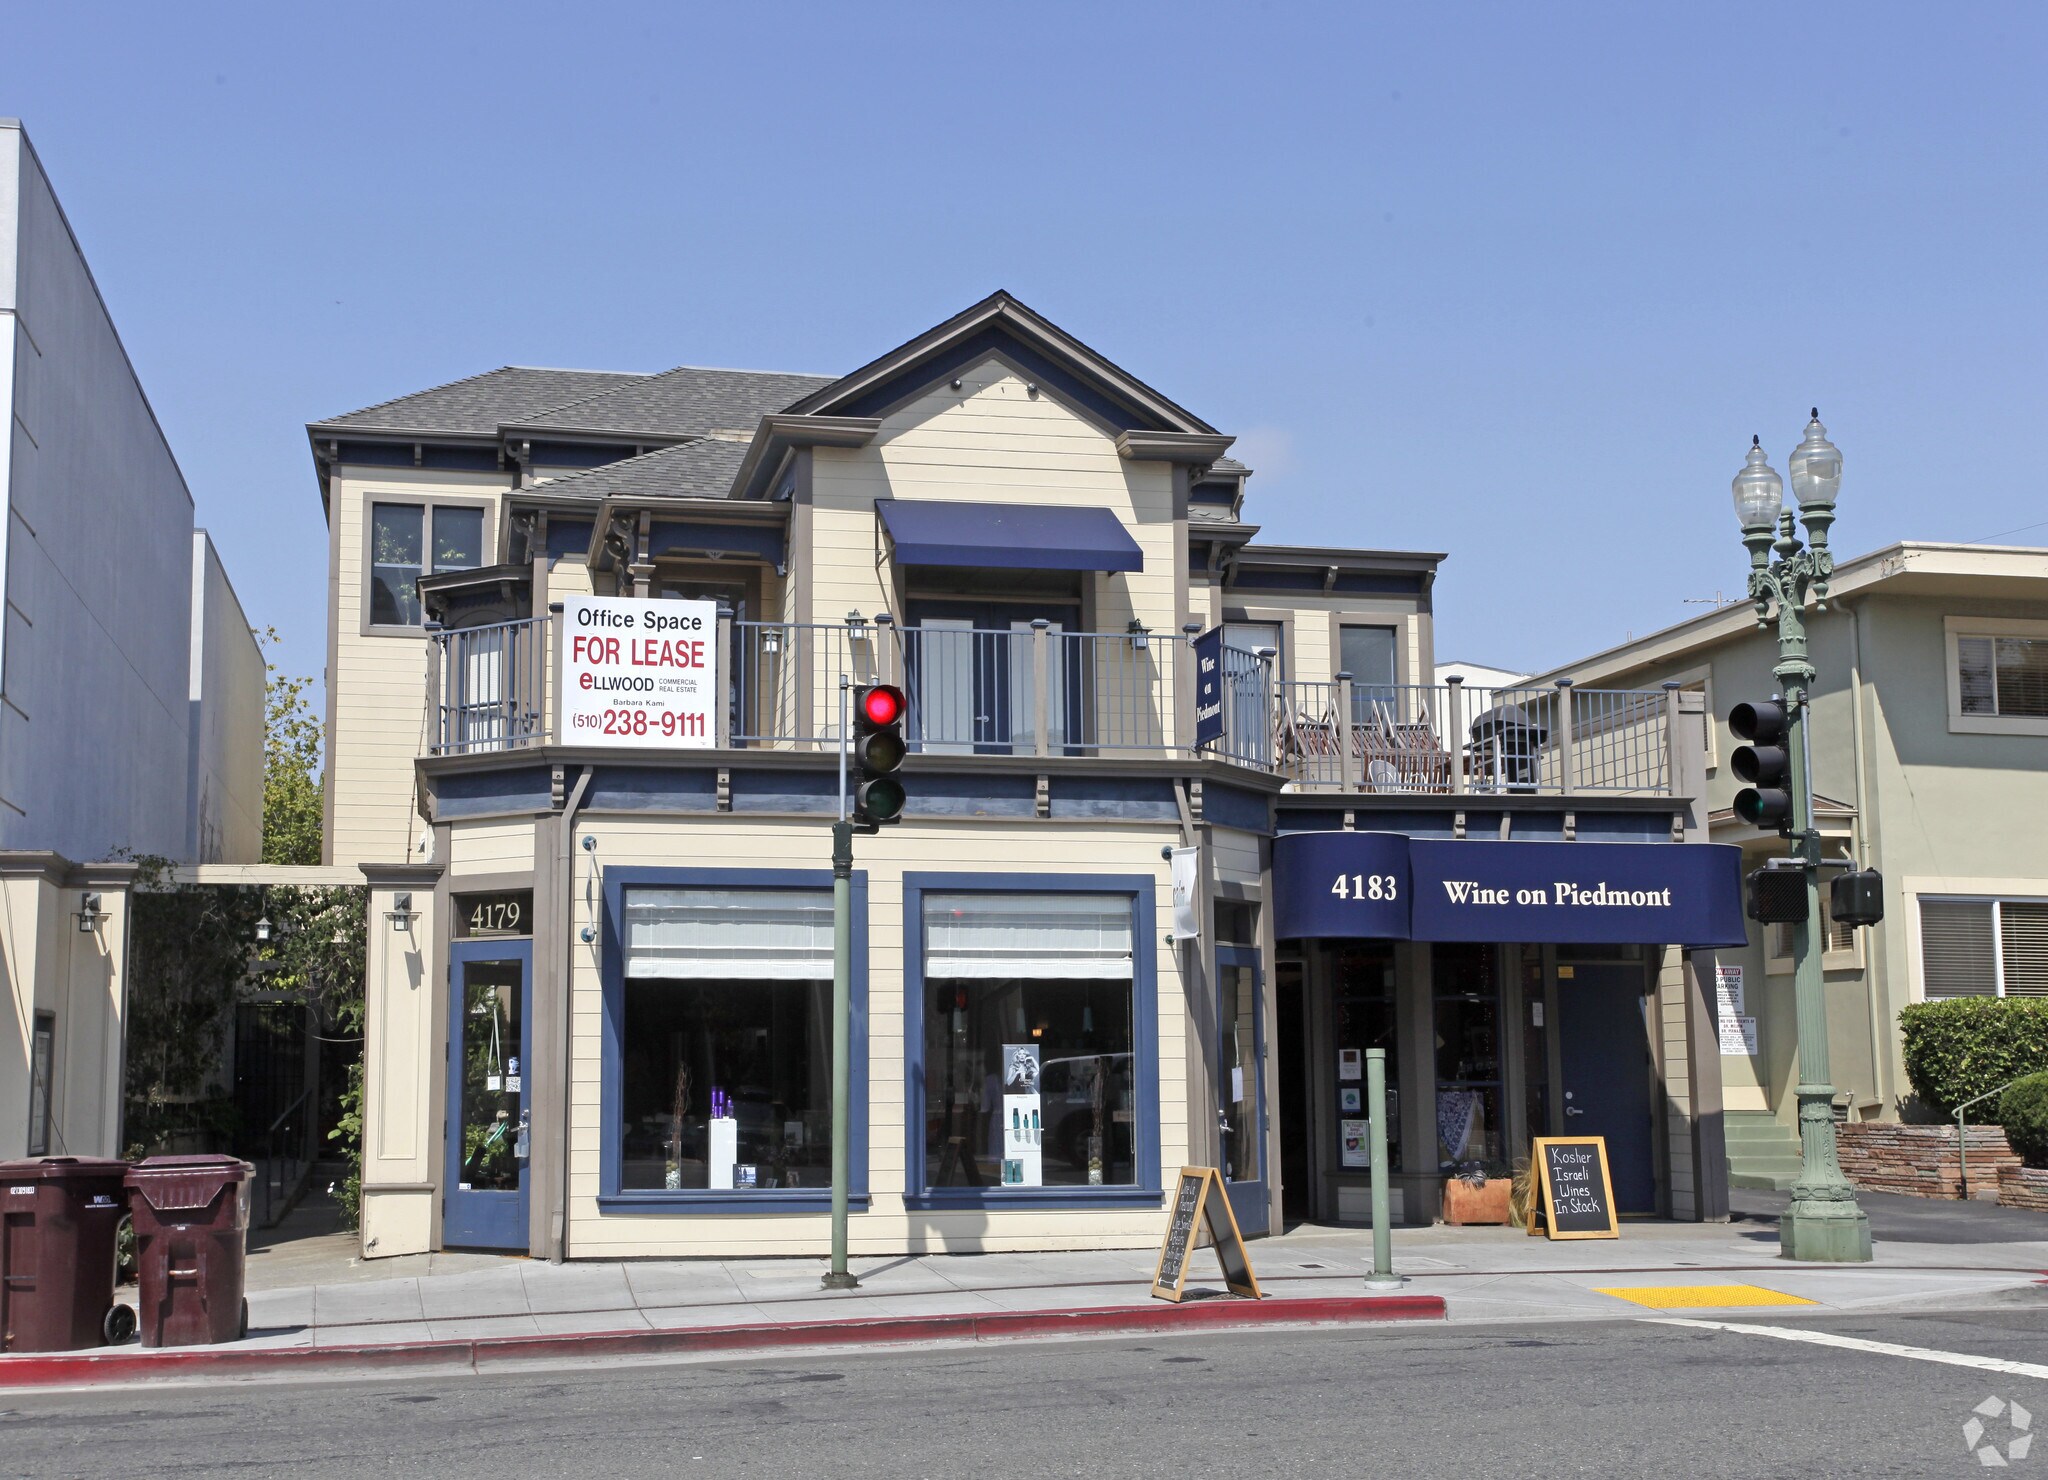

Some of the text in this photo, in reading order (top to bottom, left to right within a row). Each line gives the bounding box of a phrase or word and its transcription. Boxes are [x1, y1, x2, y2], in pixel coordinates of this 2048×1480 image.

[577, 608, 702, 632] Office Space
[573, 635, 705, 668] FOR LEASE
[1200, 656, 1215, 674] Wine
[1204, 682, 1212, 695] on
[645, 699, 665, 707] Kami
[1196, 700, 1221, 723] Piedmont
[572, 709, 705, 737] (510) 238-9111
[1331, 874, 1397, 901] 4183
[1442, 880, 1672, 907] Wine on Piedmont
[470, 902, 521, 930] 4179
[1551, 1147, 1592, 1164] Kosher
[1553, 1165, 1589, 1182] Israeli
[1559, 1184, 1591, 1198] Wines
[1553, 1197, 1601, 1215] In Stock
